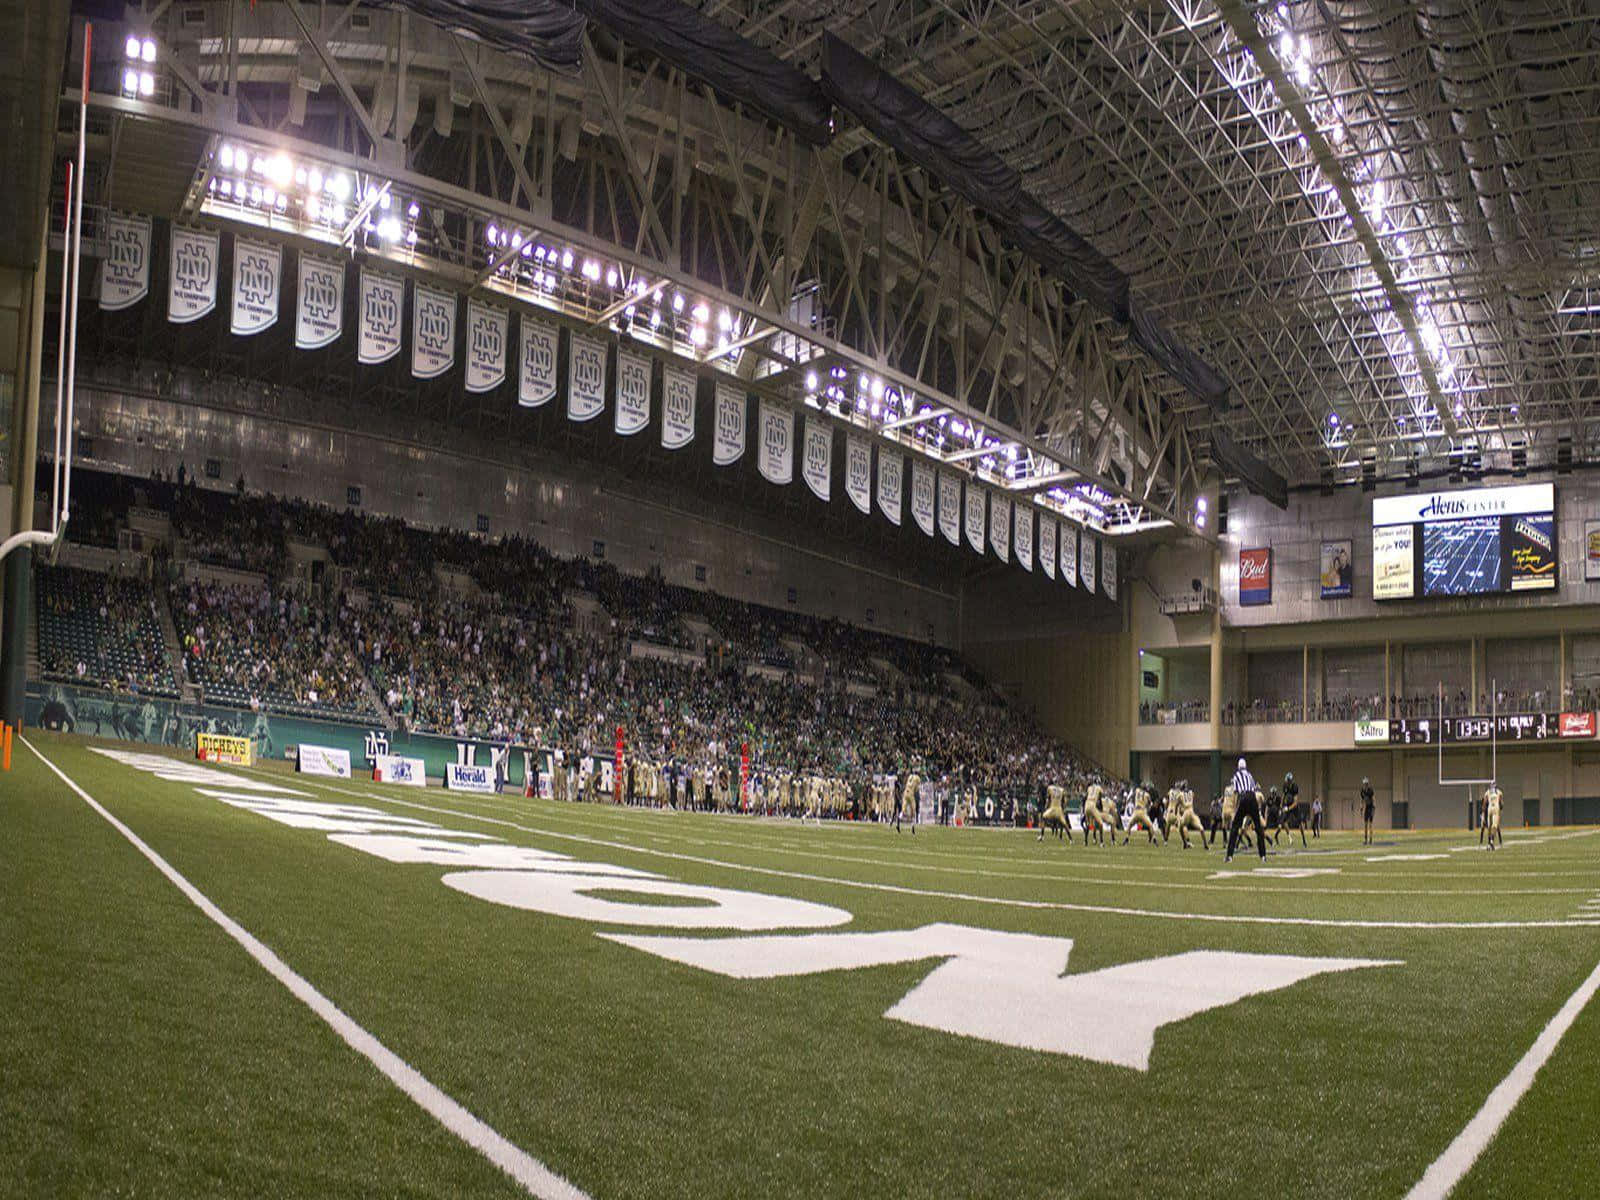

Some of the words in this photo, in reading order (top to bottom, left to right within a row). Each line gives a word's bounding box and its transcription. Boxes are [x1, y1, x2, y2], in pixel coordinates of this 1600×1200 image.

[1419, 496, 1465, 517] Alerus
[1466, 500, 1506, 511] CENTER
[1240, 559, 1268, 578] Bud
[1461, 720, 1489, 736] 13:43
[454, 766, 486, 783] Herald
